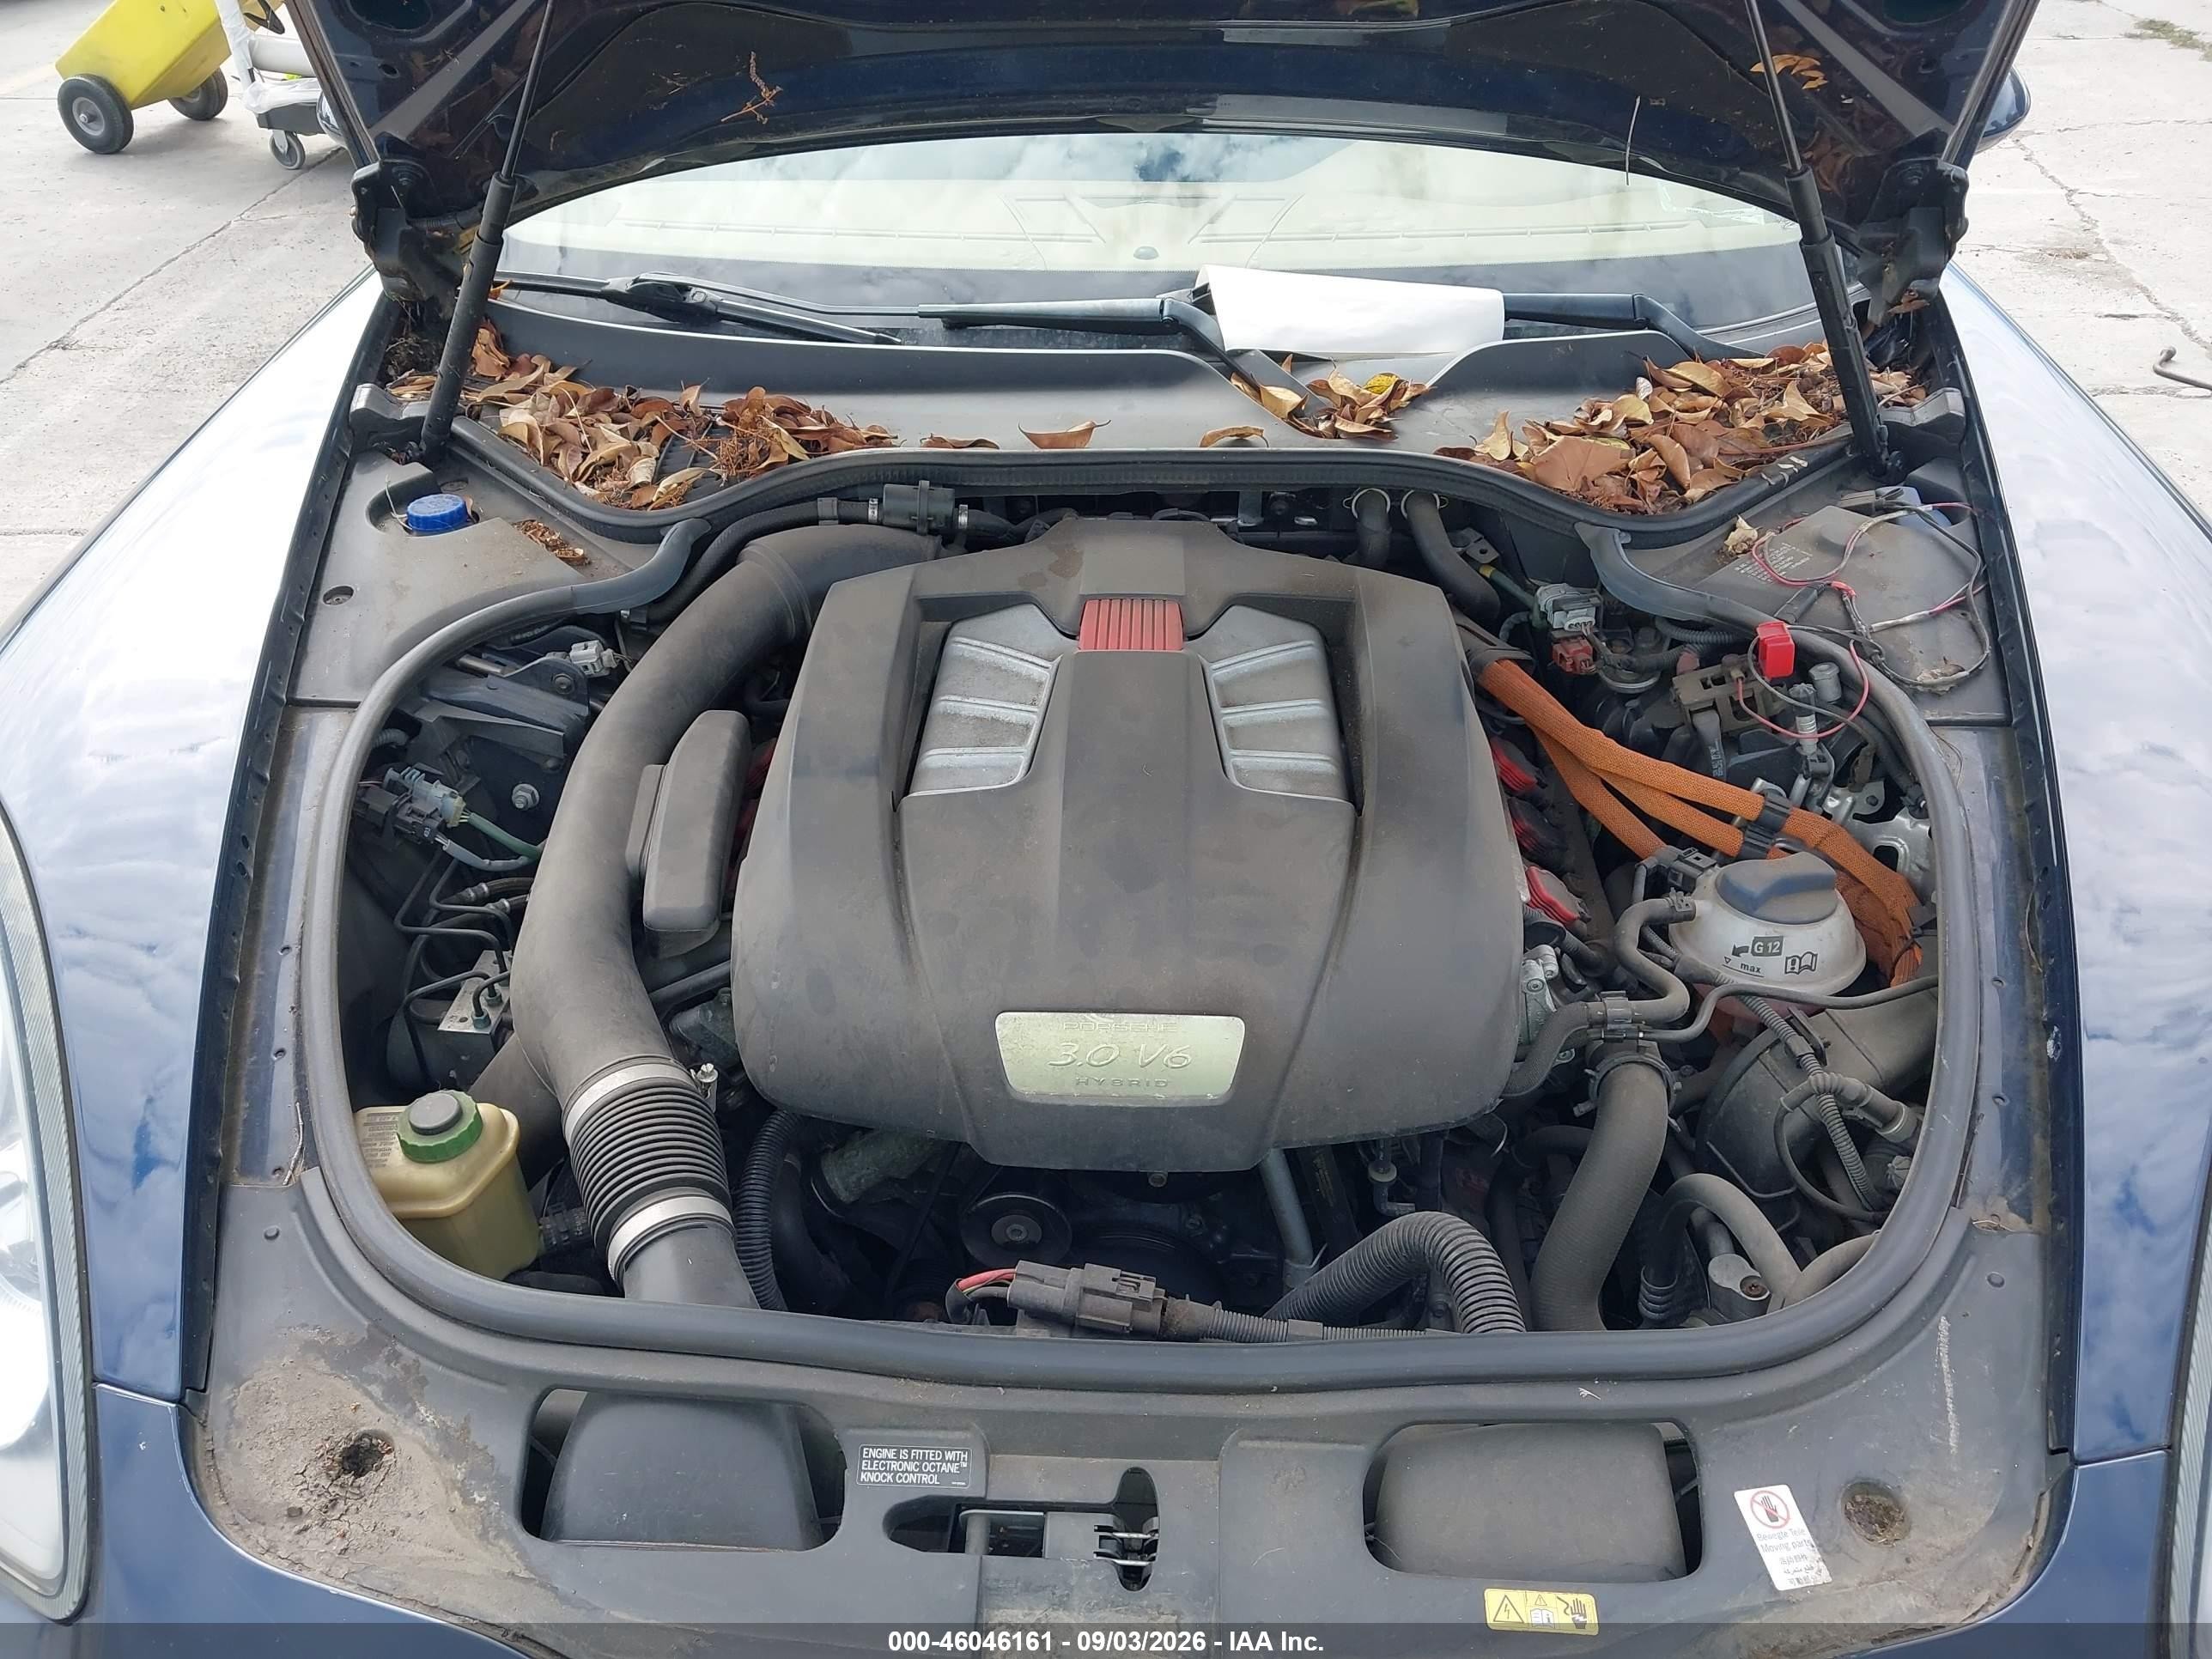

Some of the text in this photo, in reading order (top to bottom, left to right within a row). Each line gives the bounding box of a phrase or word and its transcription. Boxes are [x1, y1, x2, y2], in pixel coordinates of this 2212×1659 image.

[1753, 941, 1780, 953] G 12
[1741, 963, 1761, 973] max
[1063, 1022, 1177, 1031] PORSCHE
[1048, 1042, 1193, 1069] 3.0 V6
[1075, 1077, 1169, 1087] HYBRID
[862, 1448, 968, 1462] ENGINE IS FITTED WITH
[861, 1460, 920, 1472] ELECTRONIC
[860, 1472, 940, 1485] KNOCK CONTROL
[1760, 1539, 1812, 1553] Moving parts
